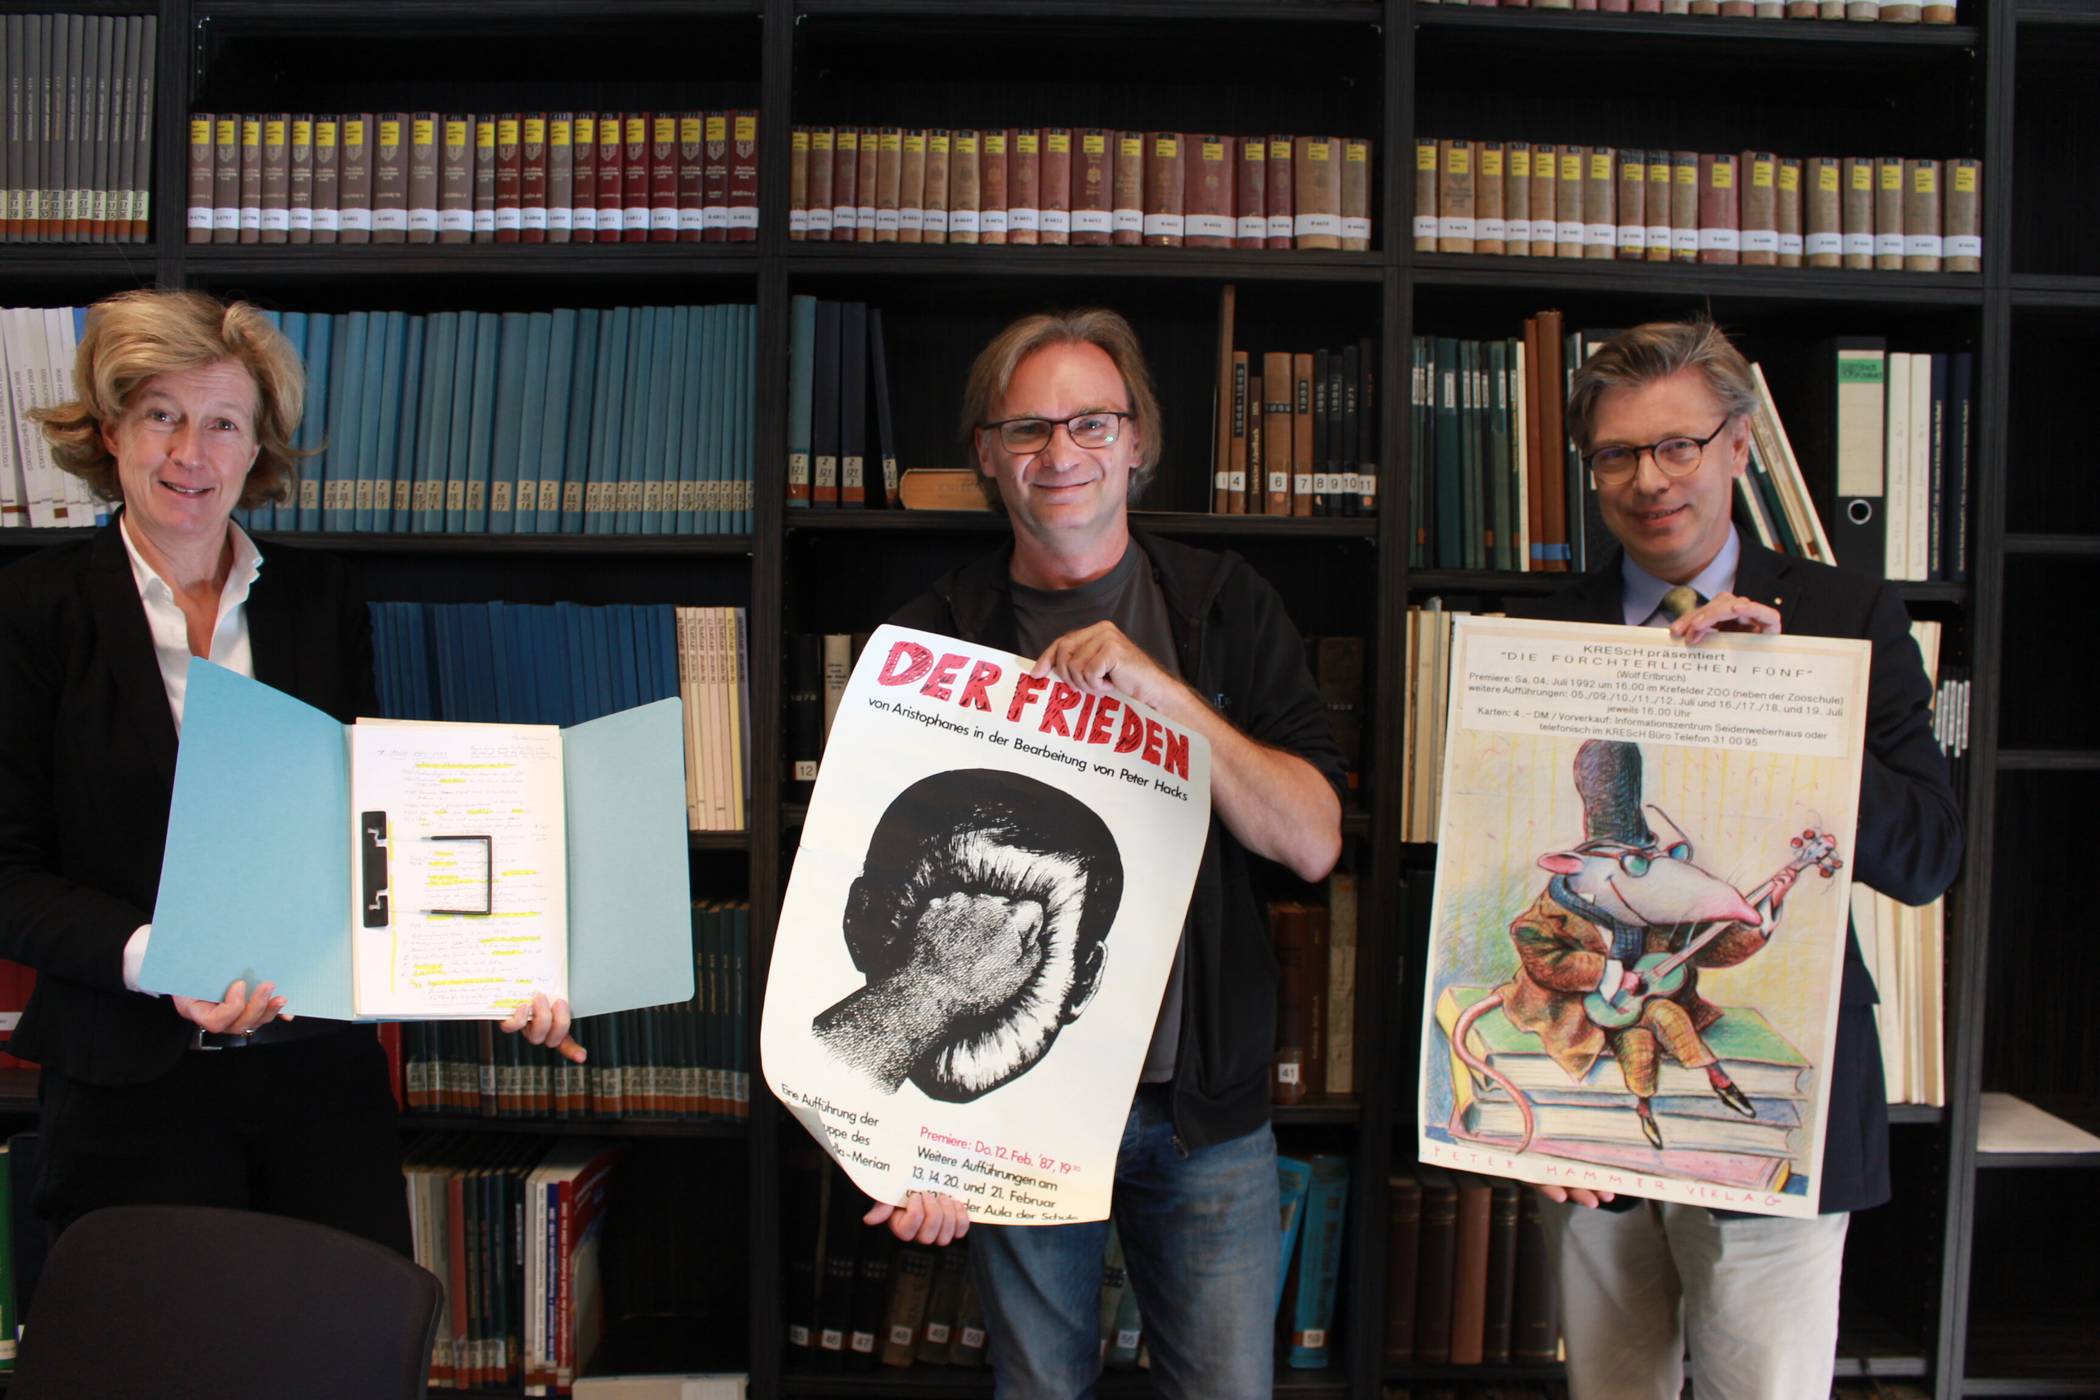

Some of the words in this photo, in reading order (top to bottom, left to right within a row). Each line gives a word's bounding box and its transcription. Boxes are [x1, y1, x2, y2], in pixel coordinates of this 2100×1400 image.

[1233, 476, 1240, 485] 4
[1275, 477, 1282, 487] 6
[1301, 479, 1308, 489] 7
[1317, 478, 1324, 488] 8
[1331, 478, 1338, 489] 9
[1344, 478, 1357, 489] 10
[1360, 480, 1371, 490] 11
[1584, 646, 1644, 656] KREScH
[1647, 650, 1725, 660] präsentiert
[1617, 671, 1640, 679] (Wolf
[1643, 672, 1686, 682] Erlbruch)
[1469, 672, 1512, 682] Premiere:
[1552, 678, 1567, 686] Juli
[1571, 680, 1596, 688] 1992
[1660, 685, 1704, 695] Krefelder
[1706, 688, 1729, 697] ZOO
[1733, 690, 1766, 699] (neben
[1769, 692, 1784, 701] der
[1788, 693, 1844, 705] Zooschule)
[1468, 685, 1501, 693] weitere
[1503, 686, 1568, 698] Aufführungen:
[1679, 698, 1695, 706] Juli
[1697, 700, 1716, 708] und
[1784, 706, 1803, 714] und
[1826, 708, 1843, 717] Juli
[878, 641, 1001, 712] DER
[1006, 672, 1190, 780] FRIEDEN
[1607, 705, 1638, 714] jeweils
[1674, 709, 1690, 718] Uhr
[1478, 707, 1512, 717] Karten:
[1534, 711, 1549, 719] DM
[1560, 712, 1612, 724] Vorverkauf:
[1615, 717, 1712, 731] Informationszentrum
[1715, 723, 1802, 738] Seidenweberhaus
[1804, 731, 1828, 739] oder
[1539, 723, 1590, 734] telefonisch
[1648, 730, 1671, 740] Büro
[1674, 732, 1710, 743] Telefon
[868, 697, 890, 714] von
[892, 702, 969, 736] Aristophanes
[974, 726, 984, 740] in
[989, 730, 1008, 747] der
[1014, 738, 1087, 772] Bearbeitung
[1094, 763, 1114, 778] von
[1120, 768, 1149, 788] Peter
[1155, 780, 1188, 802] Hacks
[800, 765, 813, 777] 12
[1282, 1068, 1295, 1078] 41
[781, 1084, 800, 1100] Eine
[802, 1093, 857, 1124] Aufführung
[860, 1112, 880, 1127] der
[851, 1129, 870, 1146] des
[920, 1126, 971, 1150] Premiere:
[975, 1140, 992, 1156] Do.
[1011, 1150, 1033, 1166] Feb.
[917, 1146, 957, 1166] Weitere
[961, 1158, 1036, 1186] Aufführungen
[1039, 1180, 1058, 1192] am
[912, 1166, 924, 1180] 13.
[928, 1170, 940, 1184] 14.
[944, 1174, 959, 1189] 20.
[963, 1182, 986, 1195] und
[991, 1185, 1004, 1199] 21.
[1010, 1190, 1056, 1208] Februar
[1545, 1164, 1666, 1192] HAMMER
[1685, 1184, 1782, 1207] VERLAG
[984, 1205, 1012, 1217] Aula
[1016, 1209, 1036, 1219] der
